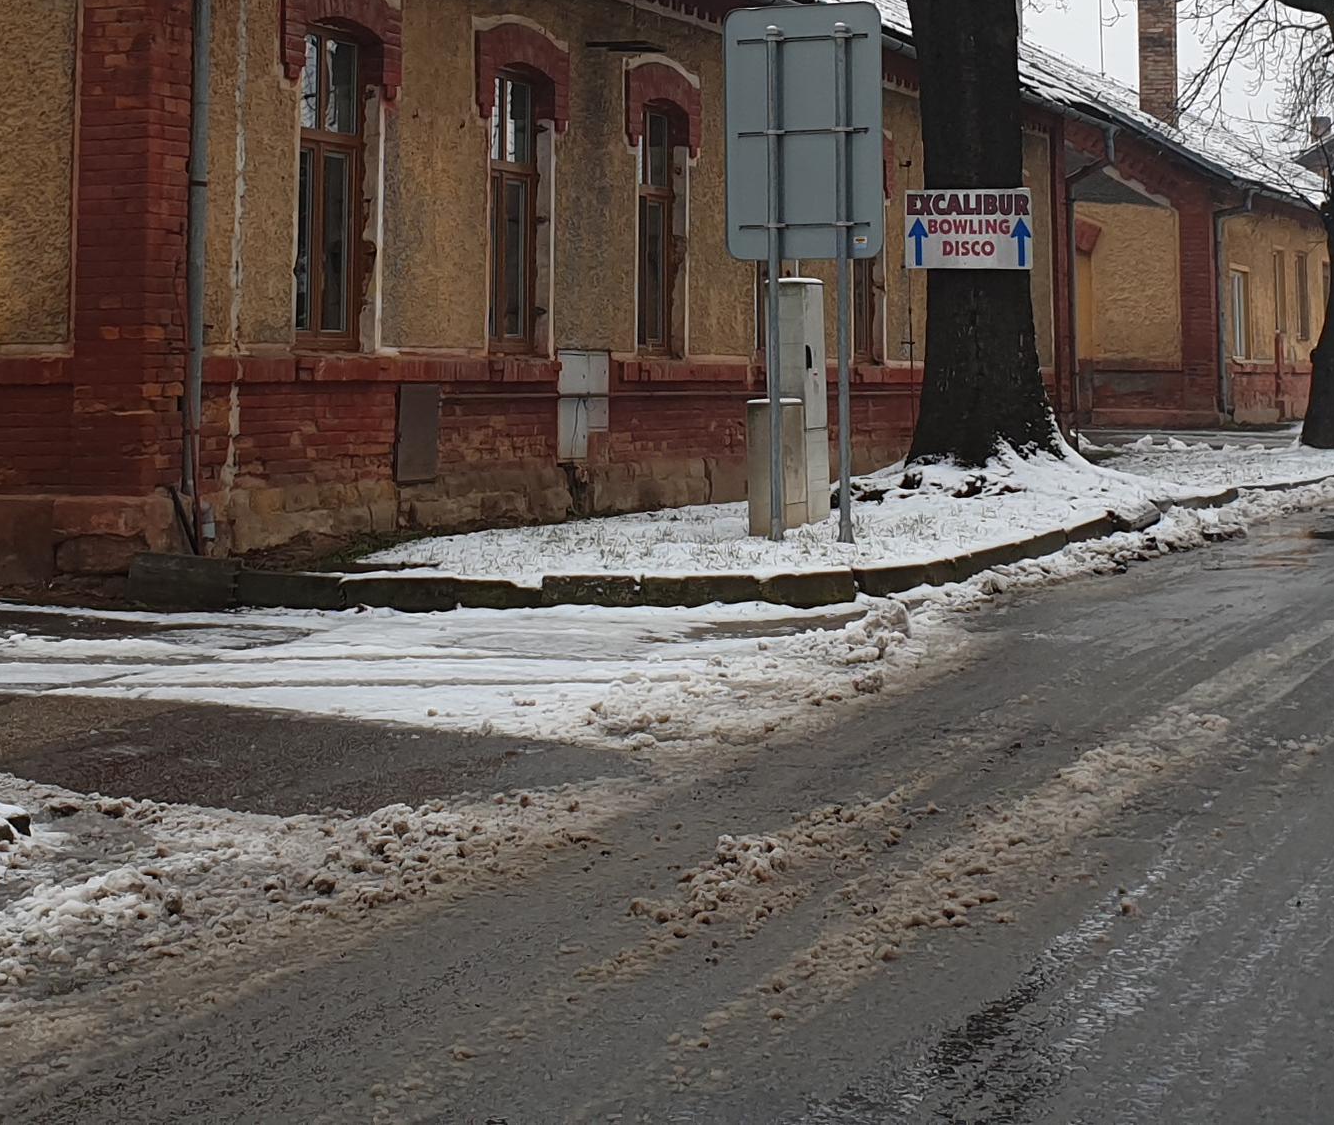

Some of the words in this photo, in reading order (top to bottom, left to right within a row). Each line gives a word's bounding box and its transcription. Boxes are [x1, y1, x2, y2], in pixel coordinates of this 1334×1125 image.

[906, 193, 1030, 216] EXCALIBUR
[927, 218, 1011, 235] BOWLING
[942, 240, 995, 257] DISCO
